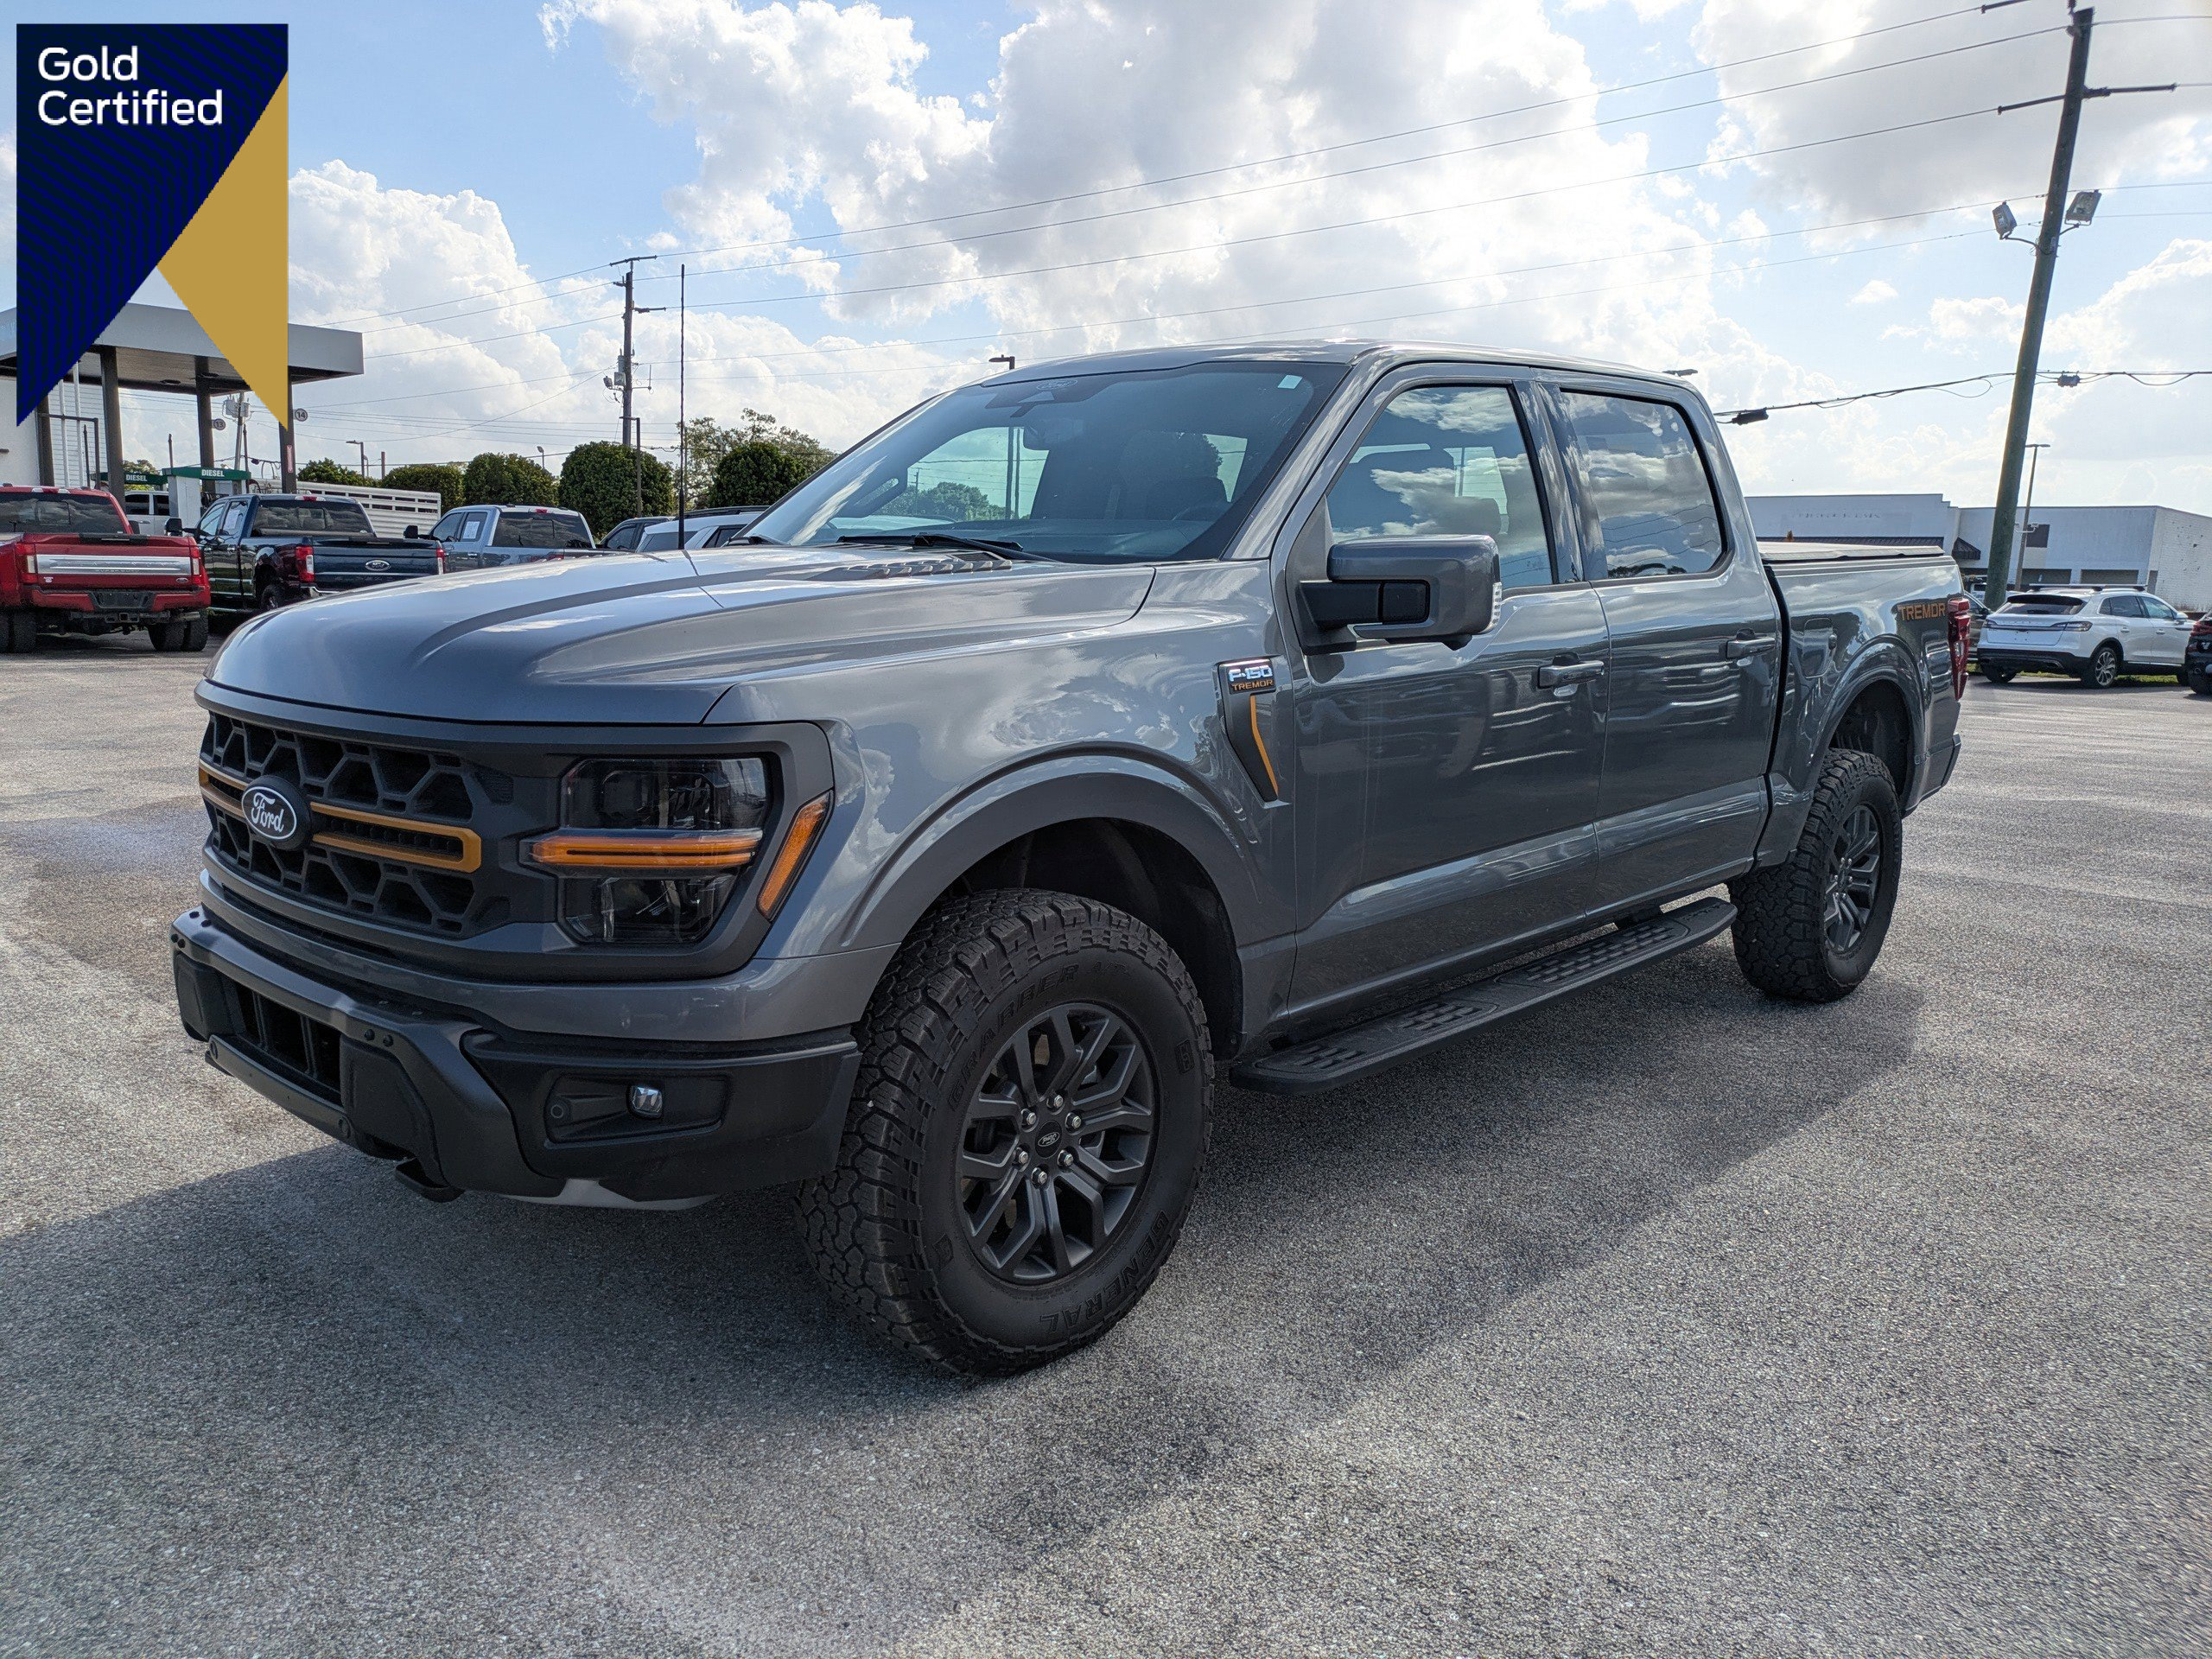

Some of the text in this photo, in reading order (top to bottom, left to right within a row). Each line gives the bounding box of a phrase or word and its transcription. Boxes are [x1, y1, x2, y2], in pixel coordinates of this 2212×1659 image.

[201, 468, 225, 477] DIESEL
[1897, 603, 1947, 621] TREMOR
[1228, 664, 1273, 682] F-150
[1231, 679, 1274, 691] TREMOR
[251, 791, 285, 833] Ford
[947, 963, 1080, 1113] GRABBER
[1040, 1210, 1170, 1333] GENERAL
